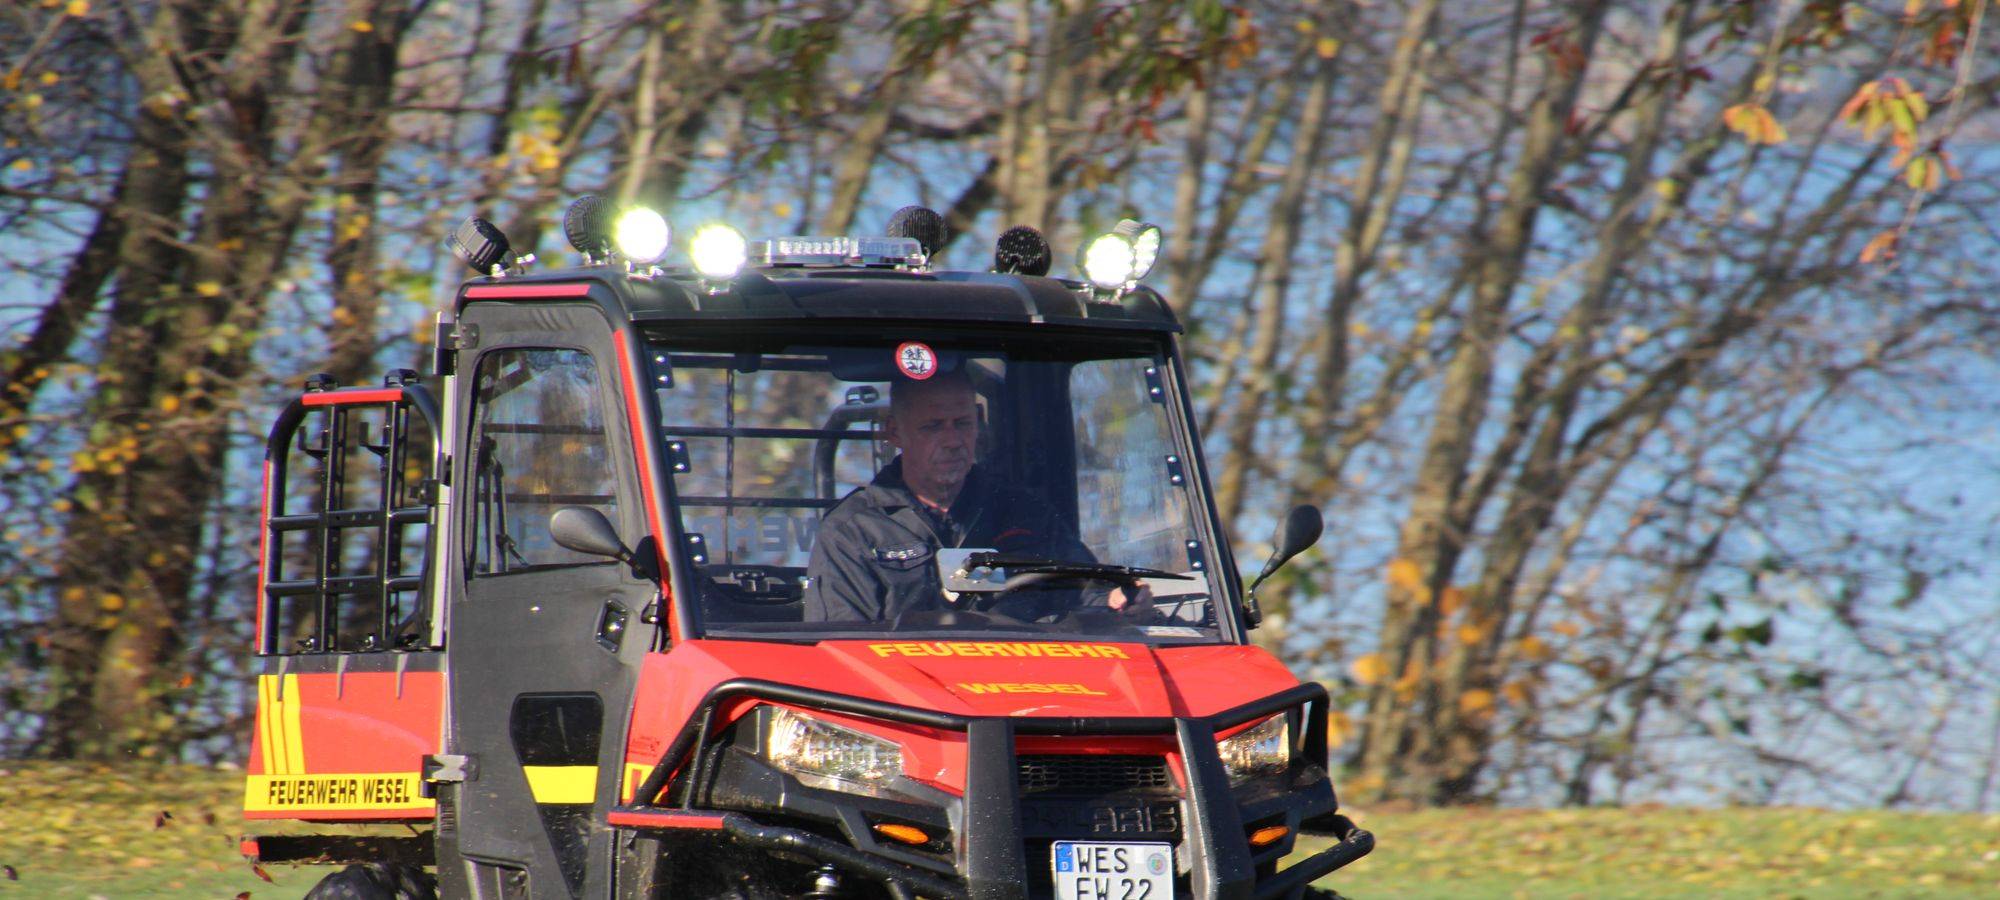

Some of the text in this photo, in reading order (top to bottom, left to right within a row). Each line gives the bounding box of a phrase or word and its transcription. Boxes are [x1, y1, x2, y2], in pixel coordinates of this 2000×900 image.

[867, 642, 1131, 660] FEUERWEHR
[957, 682, 1108, 696] WESEL
[268, 778, 411, 805] FEUERWEHR WESEL
[1076, 847, 1129, 873] WES
[1121, 878, 1152, 900] 22
